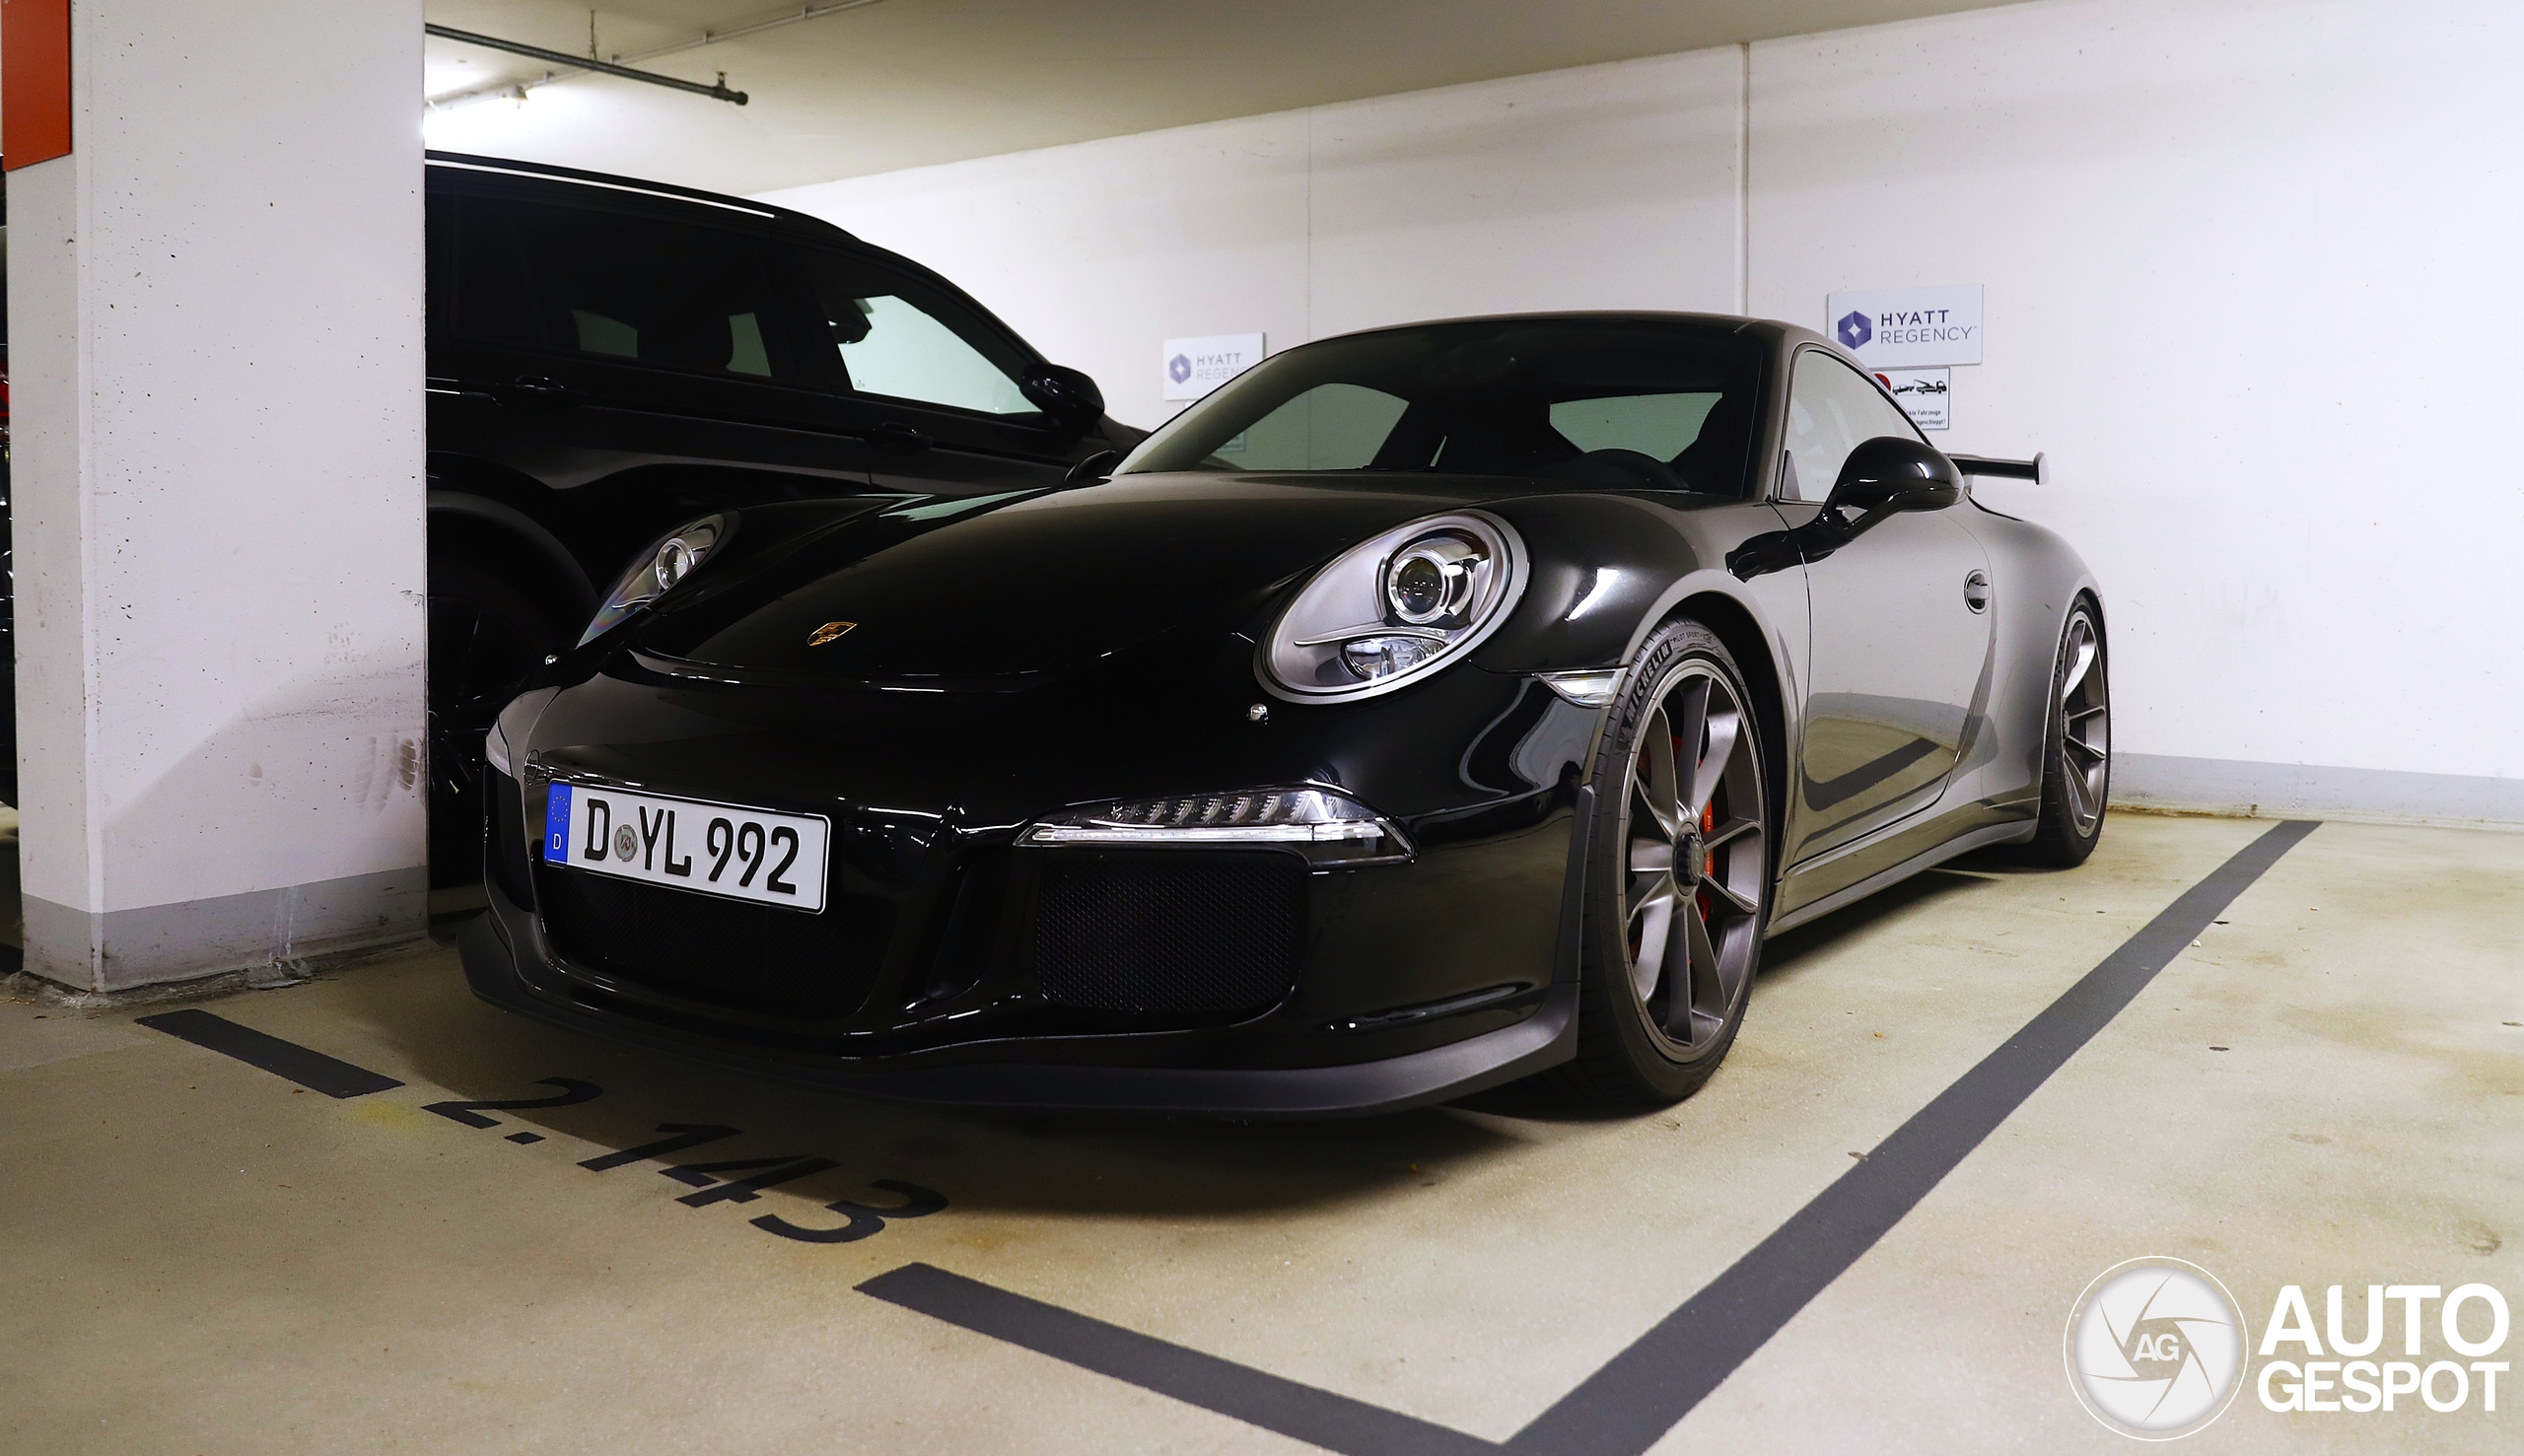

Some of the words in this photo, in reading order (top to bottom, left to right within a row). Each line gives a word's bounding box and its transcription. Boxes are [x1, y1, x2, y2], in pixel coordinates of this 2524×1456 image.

[1880, 310, 1949, 326] HYATT
[1880, 326, 1973, 344] REGENCY
[1196, 352, 1241, 366] HYATT
[1196, 366, 1246, 380] REGEN
[1626, 643, 1670, 723] MICHELIN
[552, 833, 562, 851] D
[584, 797, 610, 862] D
[639, 805, 692, 877] YL
[707, 817, 800, 895] 992
[420, 1075, 949, 1243] 2.143
